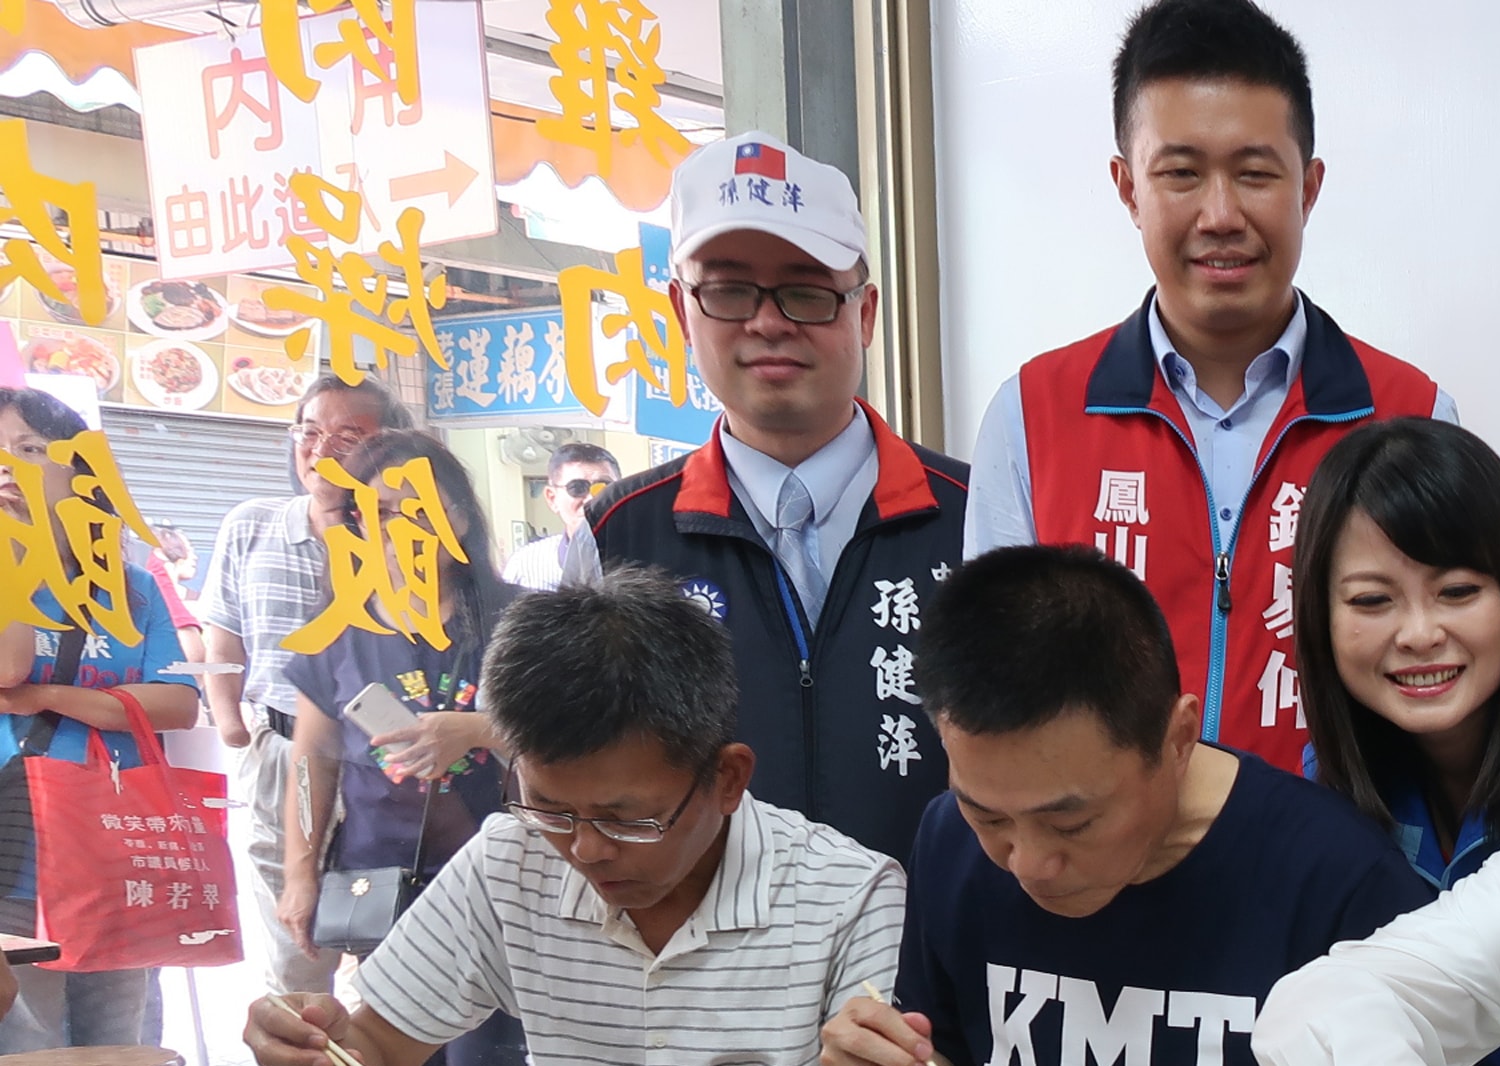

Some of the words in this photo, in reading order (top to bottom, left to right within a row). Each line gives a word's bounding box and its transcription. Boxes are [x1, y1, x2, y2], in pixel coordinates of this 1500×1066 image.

[1093, 469, 1150, 582] 鳳山
[869, 577, 923, 777] 孫健萍
[125, 879, 221, 911] 陳若翠
